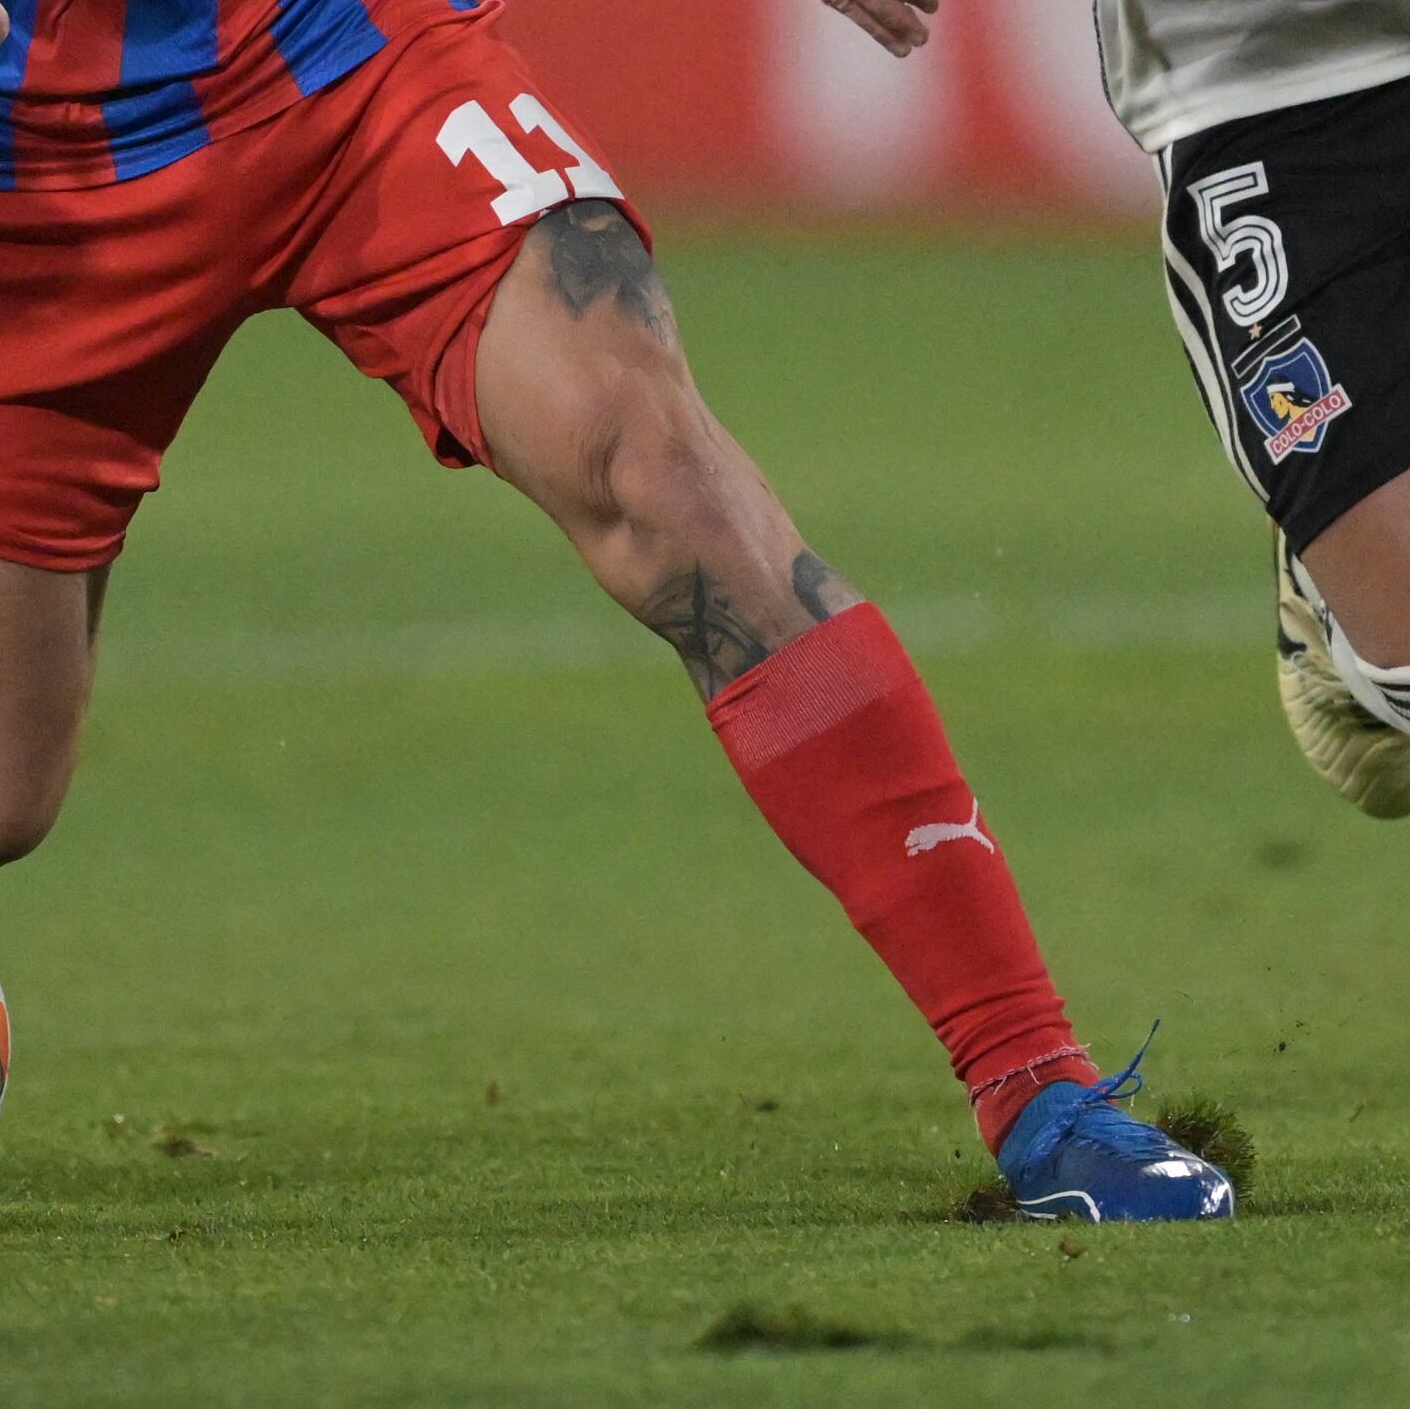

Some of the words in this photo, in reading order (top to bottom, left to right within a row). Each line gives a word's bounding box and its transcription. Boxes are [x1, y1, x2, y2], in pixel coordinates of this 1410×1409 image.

[436, 93, 625, 227] 11
[1187, 160, 1289, 327] 5
[1271, 394, 1342, 456] COLO-COLO
